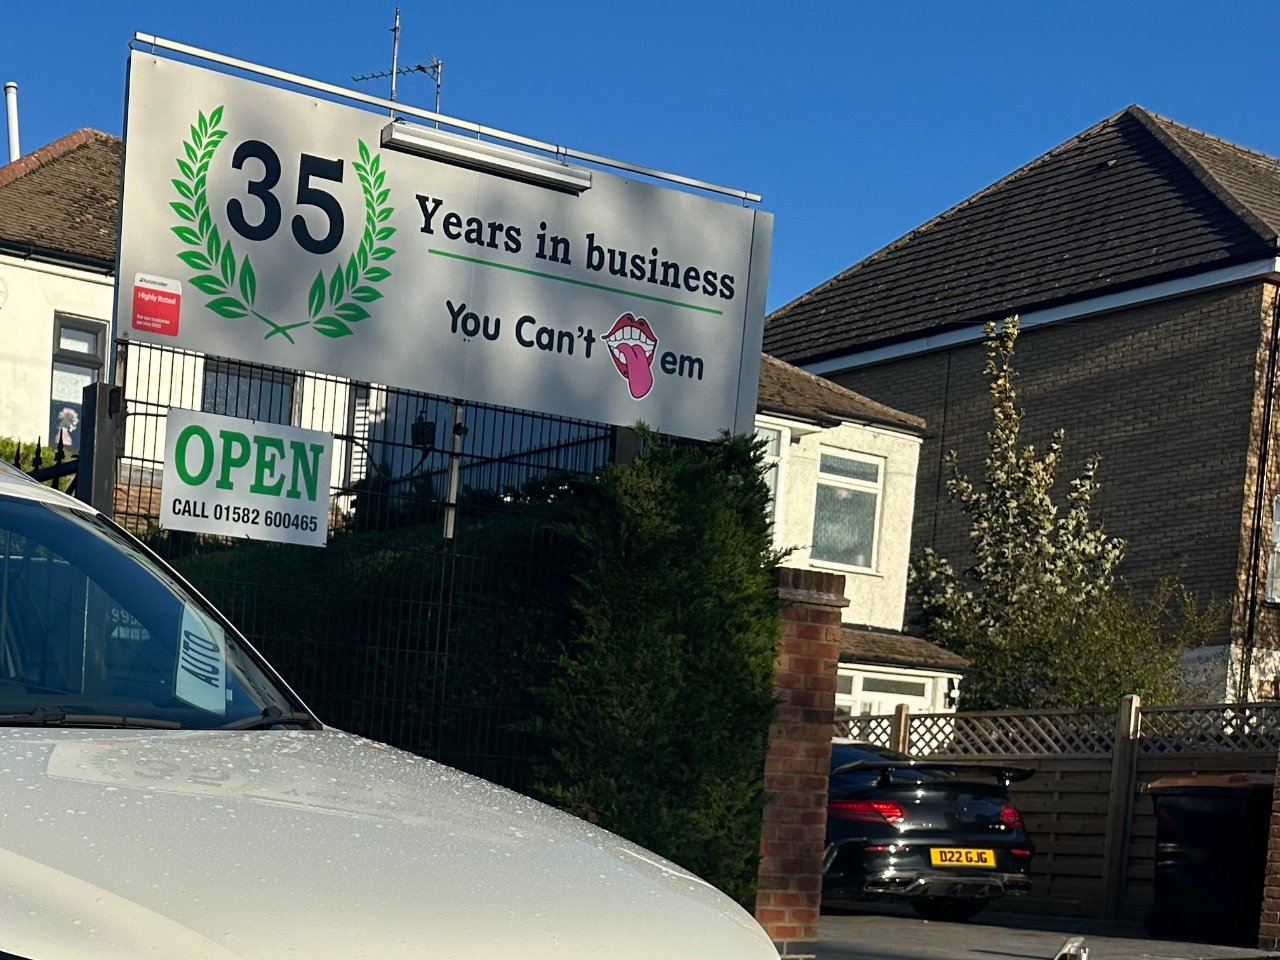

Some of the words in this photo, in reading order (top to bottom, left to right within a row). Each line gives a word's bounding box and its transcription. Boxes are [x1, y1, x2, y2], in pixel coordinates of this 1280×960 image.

[226, 140, 345, 255] 35
[415, 194, 522, 254] Years
[535, 201, 572, 265] in
[586, 233, 735, 300] business
[138, 291, 158, 302] Highly
[158, 295, 177, 305] Rated
[446, 300, 501, 341] You
[515, 315, 596, 359] Can't
[660, 351, 704, 380] em
[175, 425, 324, 502] OPEN
[172, 498, 209, 519] CALL
[214, 503, 260, 525] 01582
[264, 510, 318, 532] 600465
[181, 630, 220, 688] AUTO
[940, 850, 963, 863] D22
[965, 851, 988, 863] GJG
